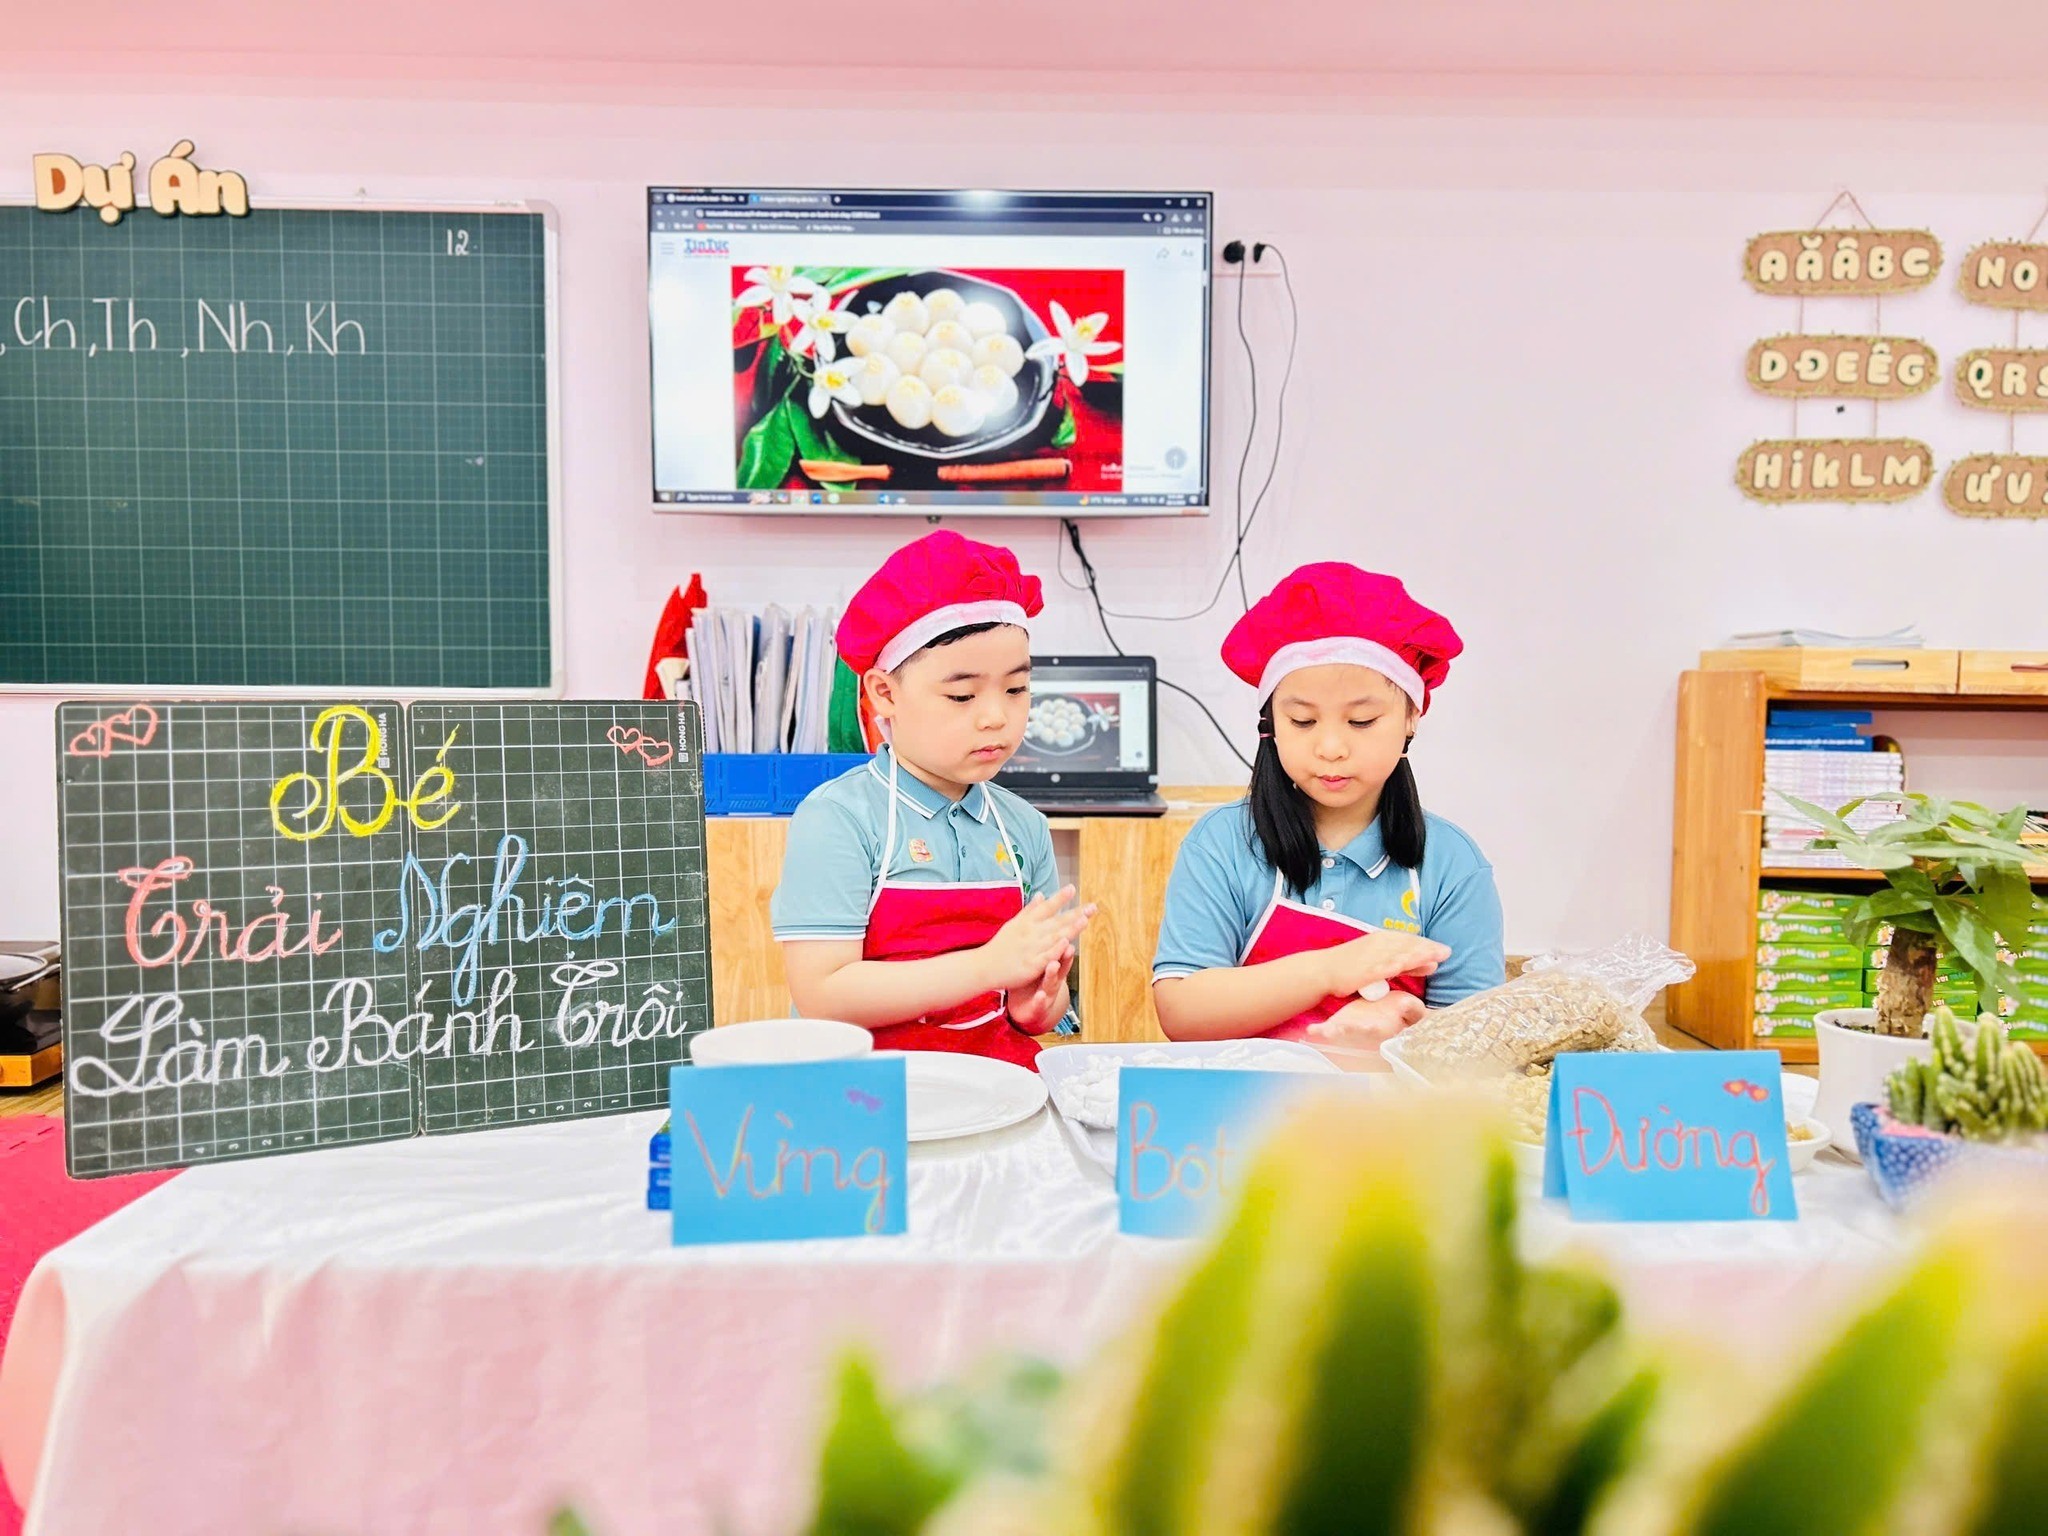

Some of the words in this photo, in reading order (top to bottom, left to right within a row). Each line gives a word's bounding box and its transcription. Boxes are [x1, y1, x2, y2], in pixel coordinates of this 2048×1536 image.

[33, 151, 136, 224] Dự
[149, 139, 251, 217] Án
[447, 229, 469, 256] 12
[1977, 256, 2048, 291] NO
[269, 704, 460, 841] Bé
[118, 856, 342, 967] Trải
[373, 834, 676, 1007] Nghiệm
[70, 993, 290, 1097] Làm
[307, 969, 535, 1073] Bánh
[551, 960, 688, 1048] Trôi
[685, 1105, 893, 1234] Vừng
[1567, 1087, 1775, 1216] Đường
